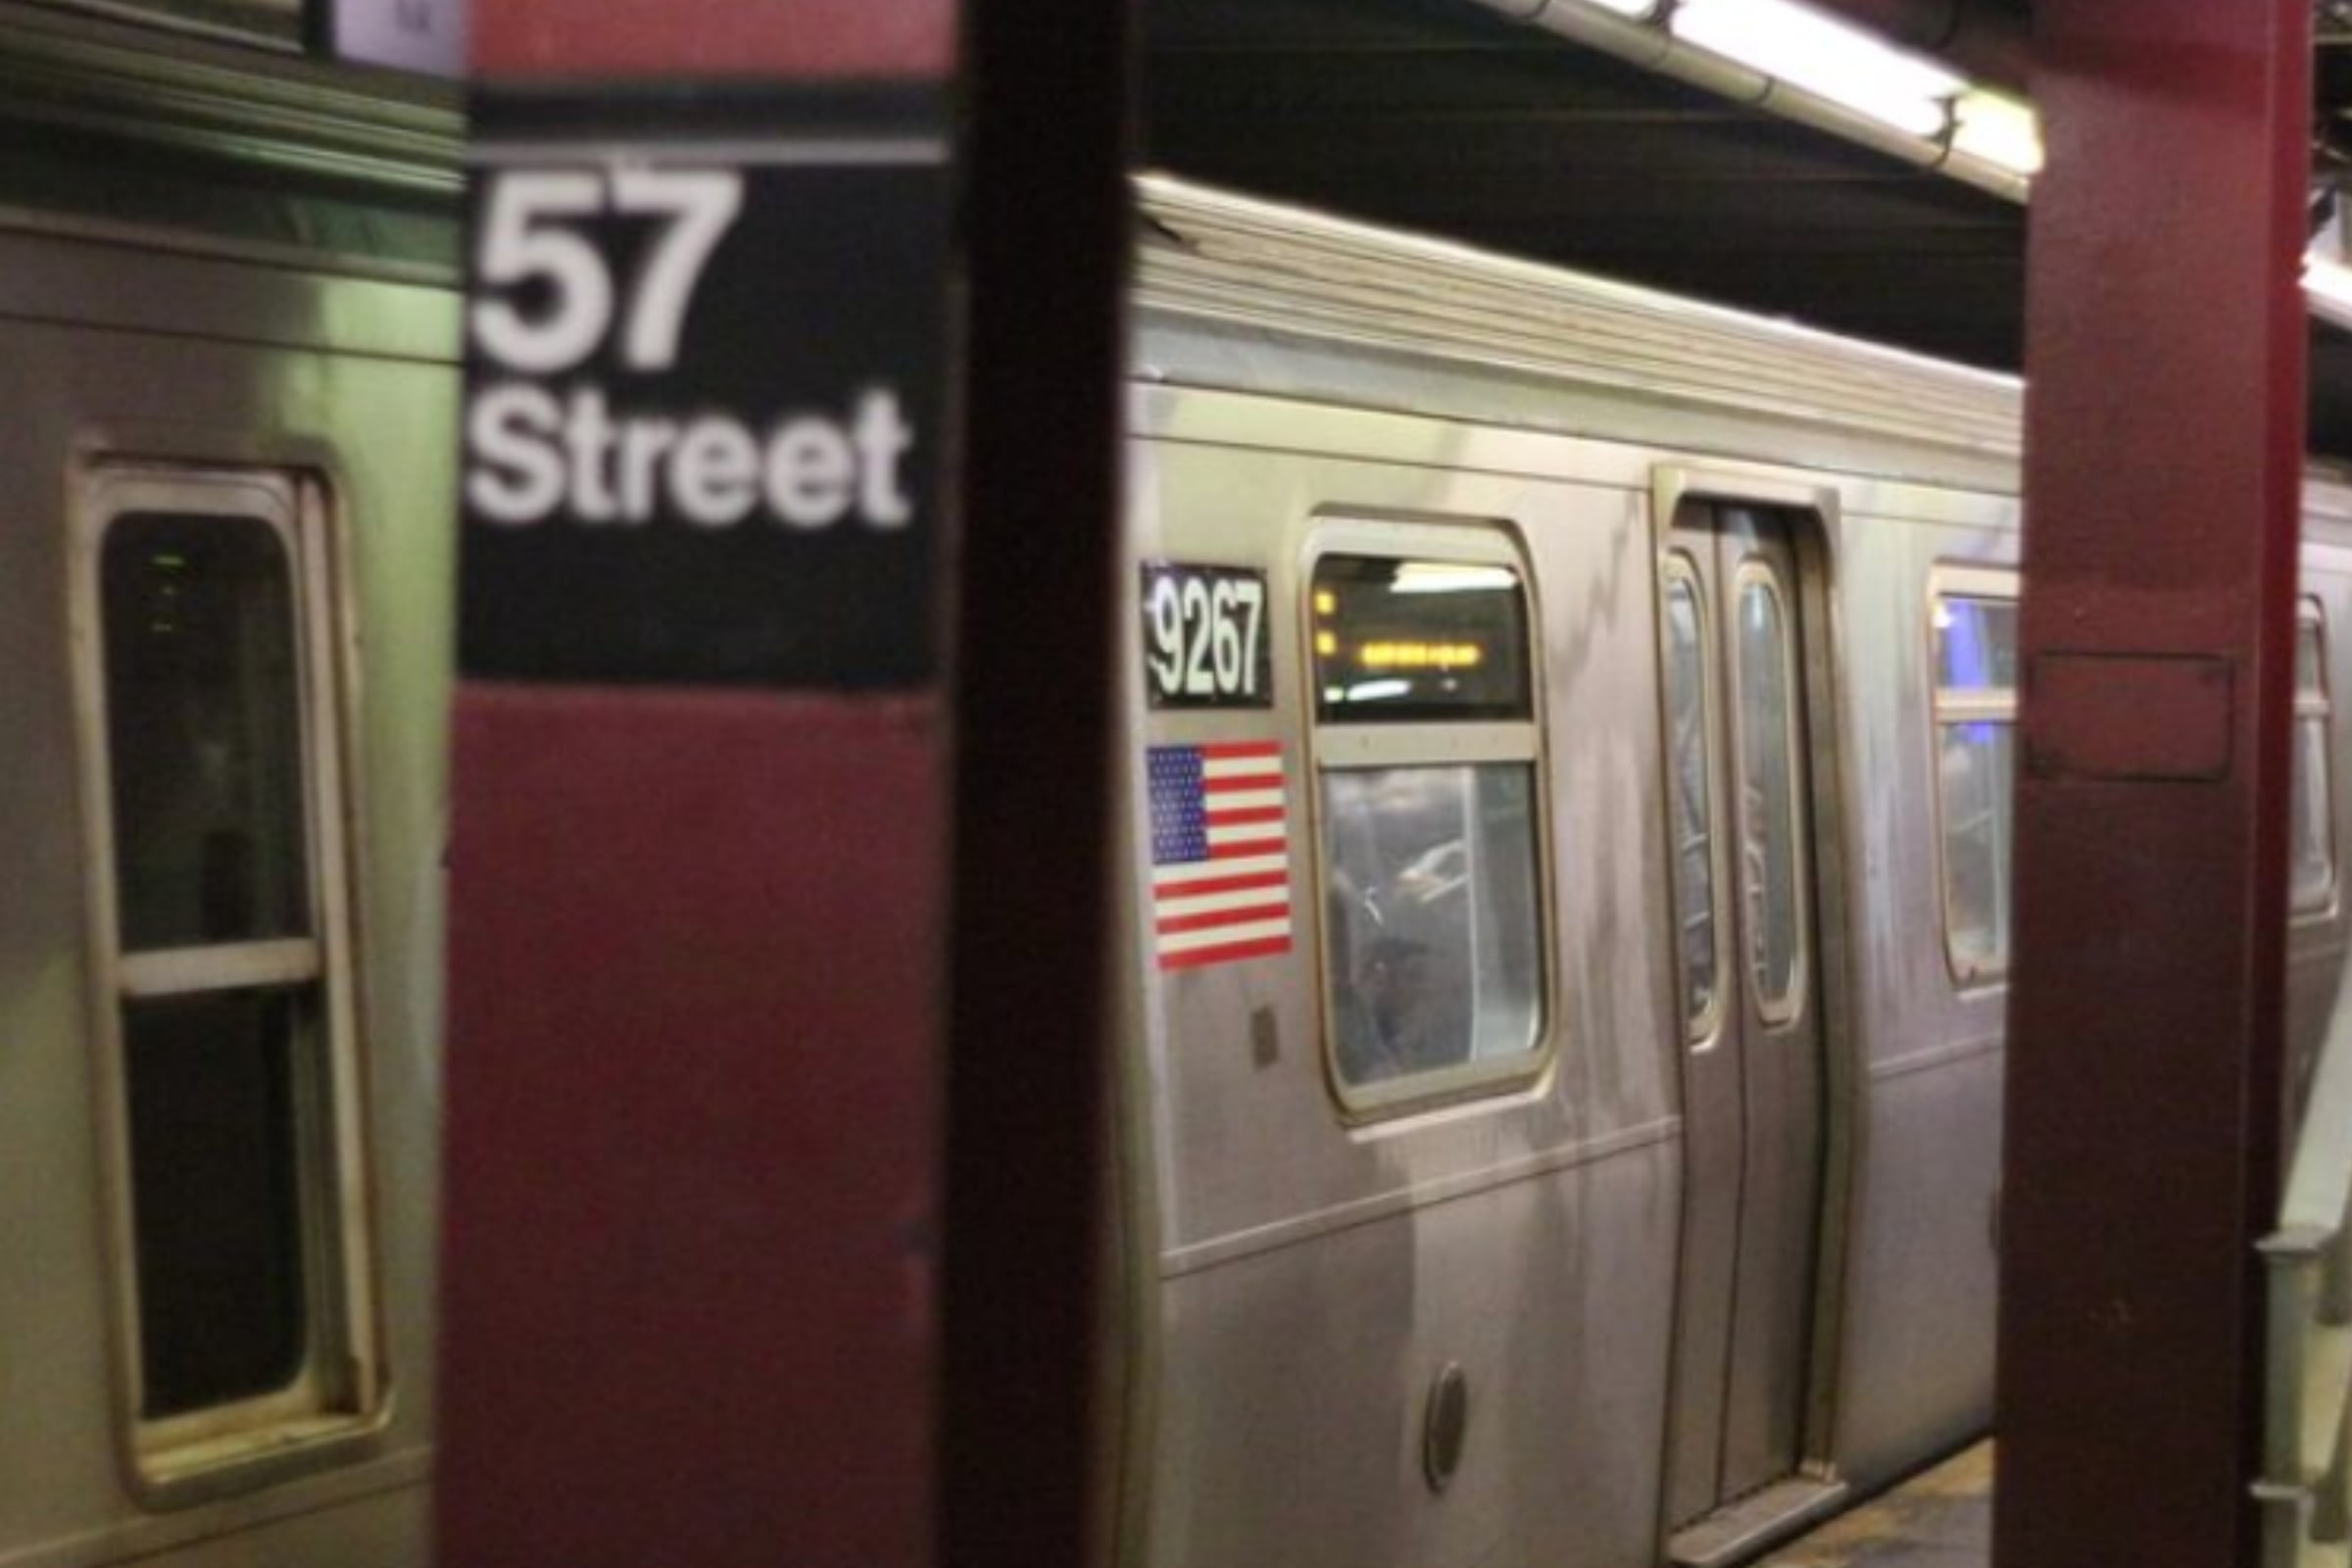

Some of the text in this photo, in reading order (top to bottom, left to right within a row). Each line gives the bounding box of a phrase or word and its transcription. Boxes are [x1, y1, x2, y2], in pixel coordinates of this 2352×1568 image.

[470, 169, 745, 375] 57
[467, 384, 913, 530] Street
[1151, 575, 1264, 698] 9267
